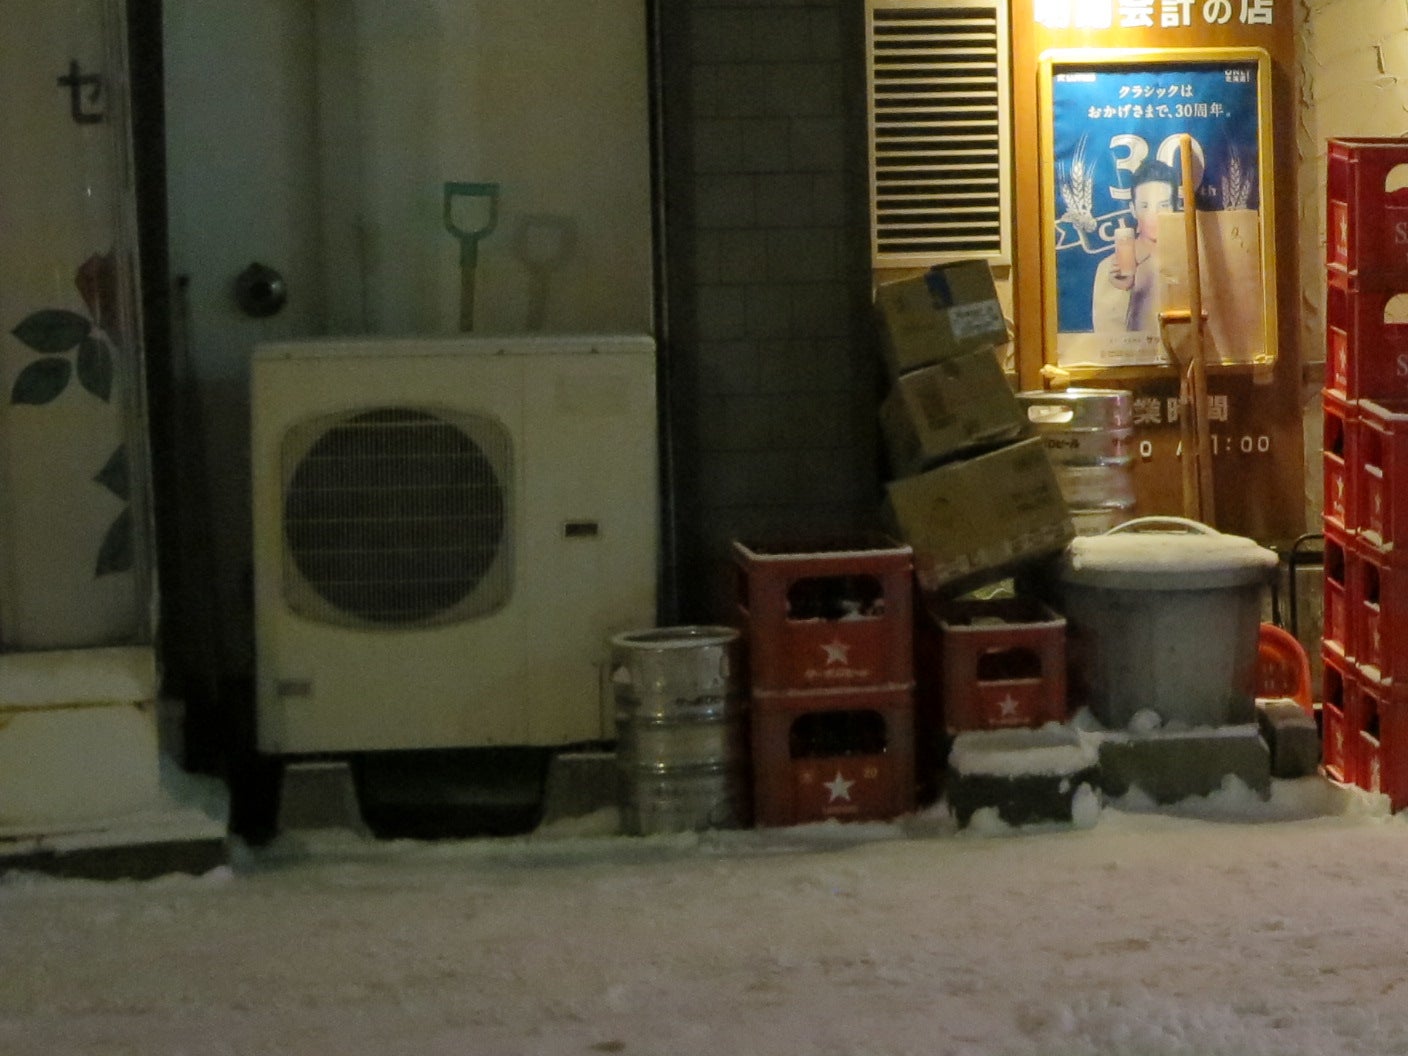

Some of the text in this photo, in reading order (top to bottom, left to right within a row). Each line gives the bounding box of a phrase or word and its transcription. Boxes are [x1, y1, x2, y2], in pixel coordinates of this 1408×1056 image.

[1118, 84, 1194, 99] クラシックは
